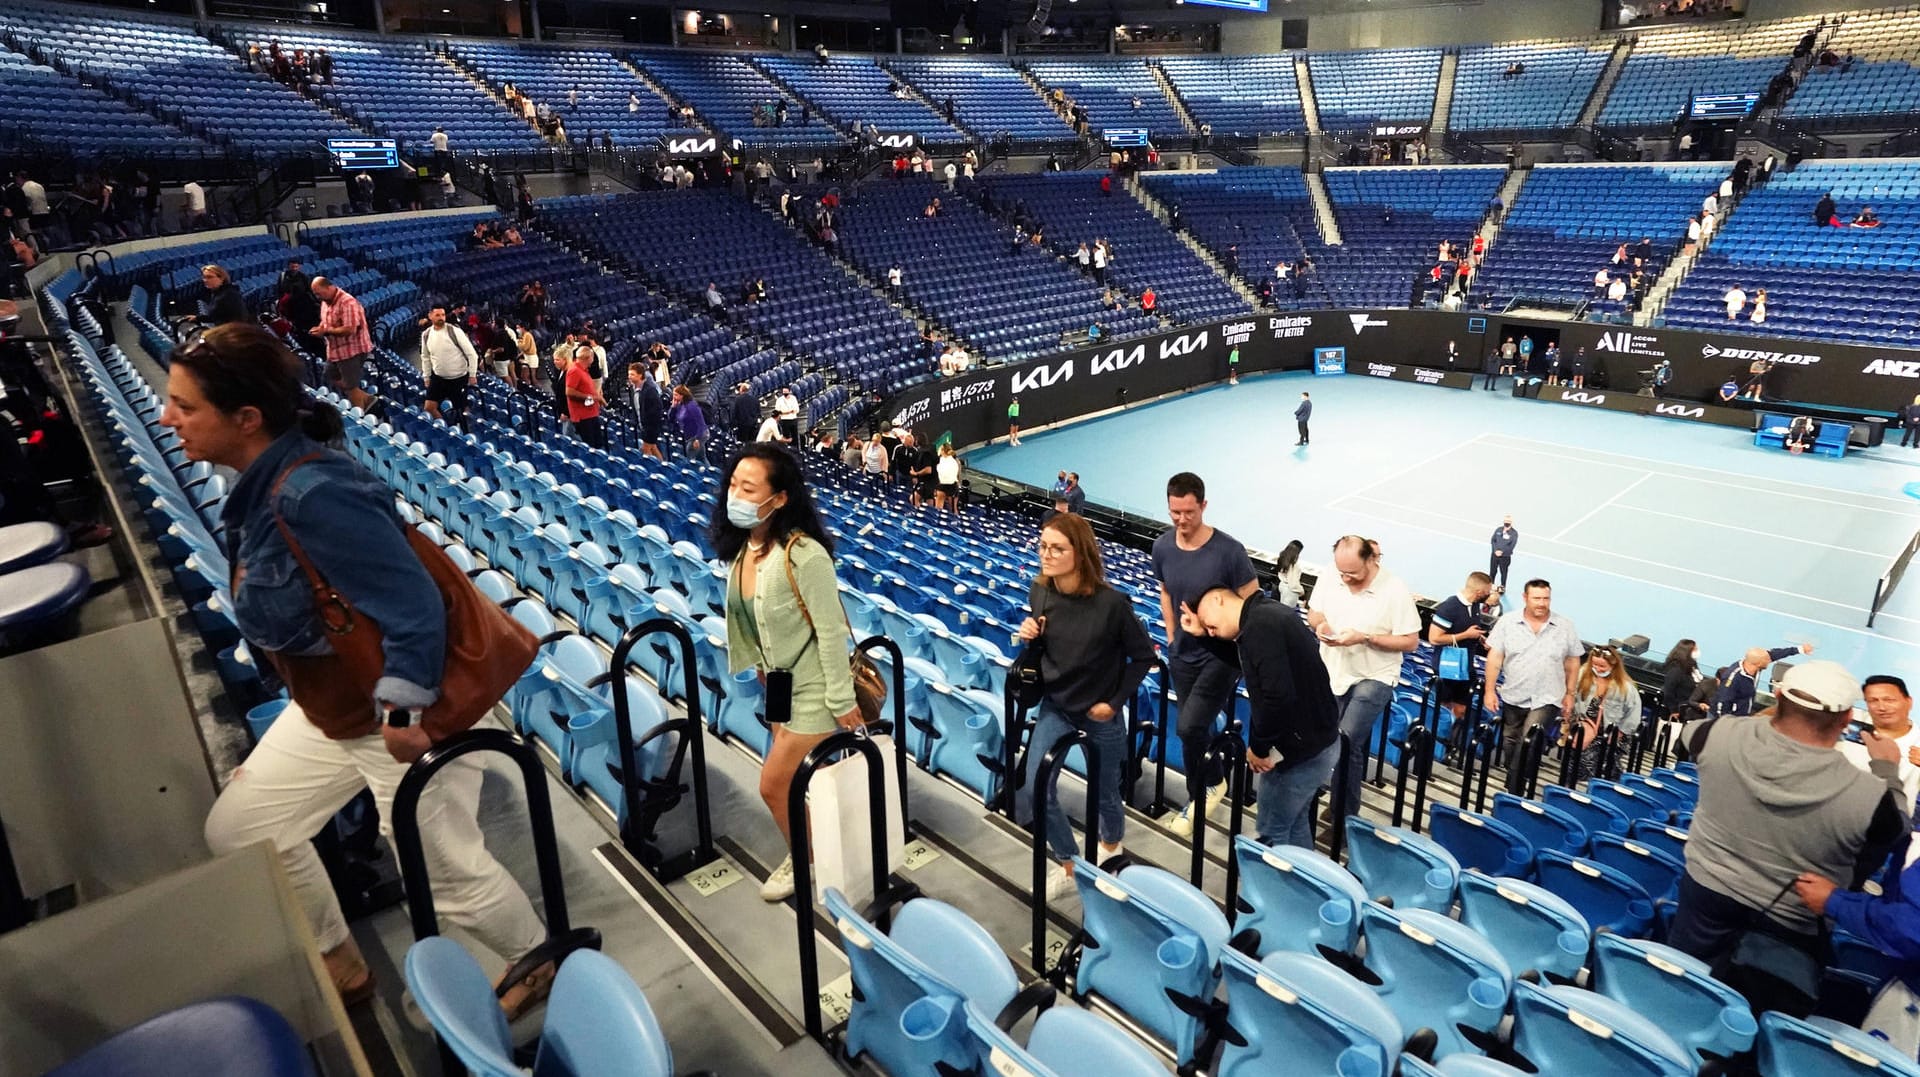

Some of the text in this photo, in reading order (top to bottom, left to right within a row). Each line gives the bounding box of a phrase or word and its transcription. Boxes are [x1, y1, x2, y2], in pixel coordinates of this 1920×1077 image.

[669, 138, 716, 153] KIA
[1222, 321, 1256, 336] Emirates
[1269, 316, 1312, 329] Emirates
[1274, 326, 1305, 338] FLY BETTER
[1159, 331, 1208, 359] KIA
[1090, 344, 1145, 375] KIA
[1720, 347, 1821, 365] DUNLOP
[1862, 359, 1920, 378] ANZ
[1011, 360, 1073, 393] KIA
[962, 379, 995, 397] 1573
[1561, 390, 1605, 405] KIA
[1655, 403, 1705, 418] KIA
[912, 847, 927, 857] R
[712, 868, 729, 879] S
[1047, 940, 1063, 953] R
